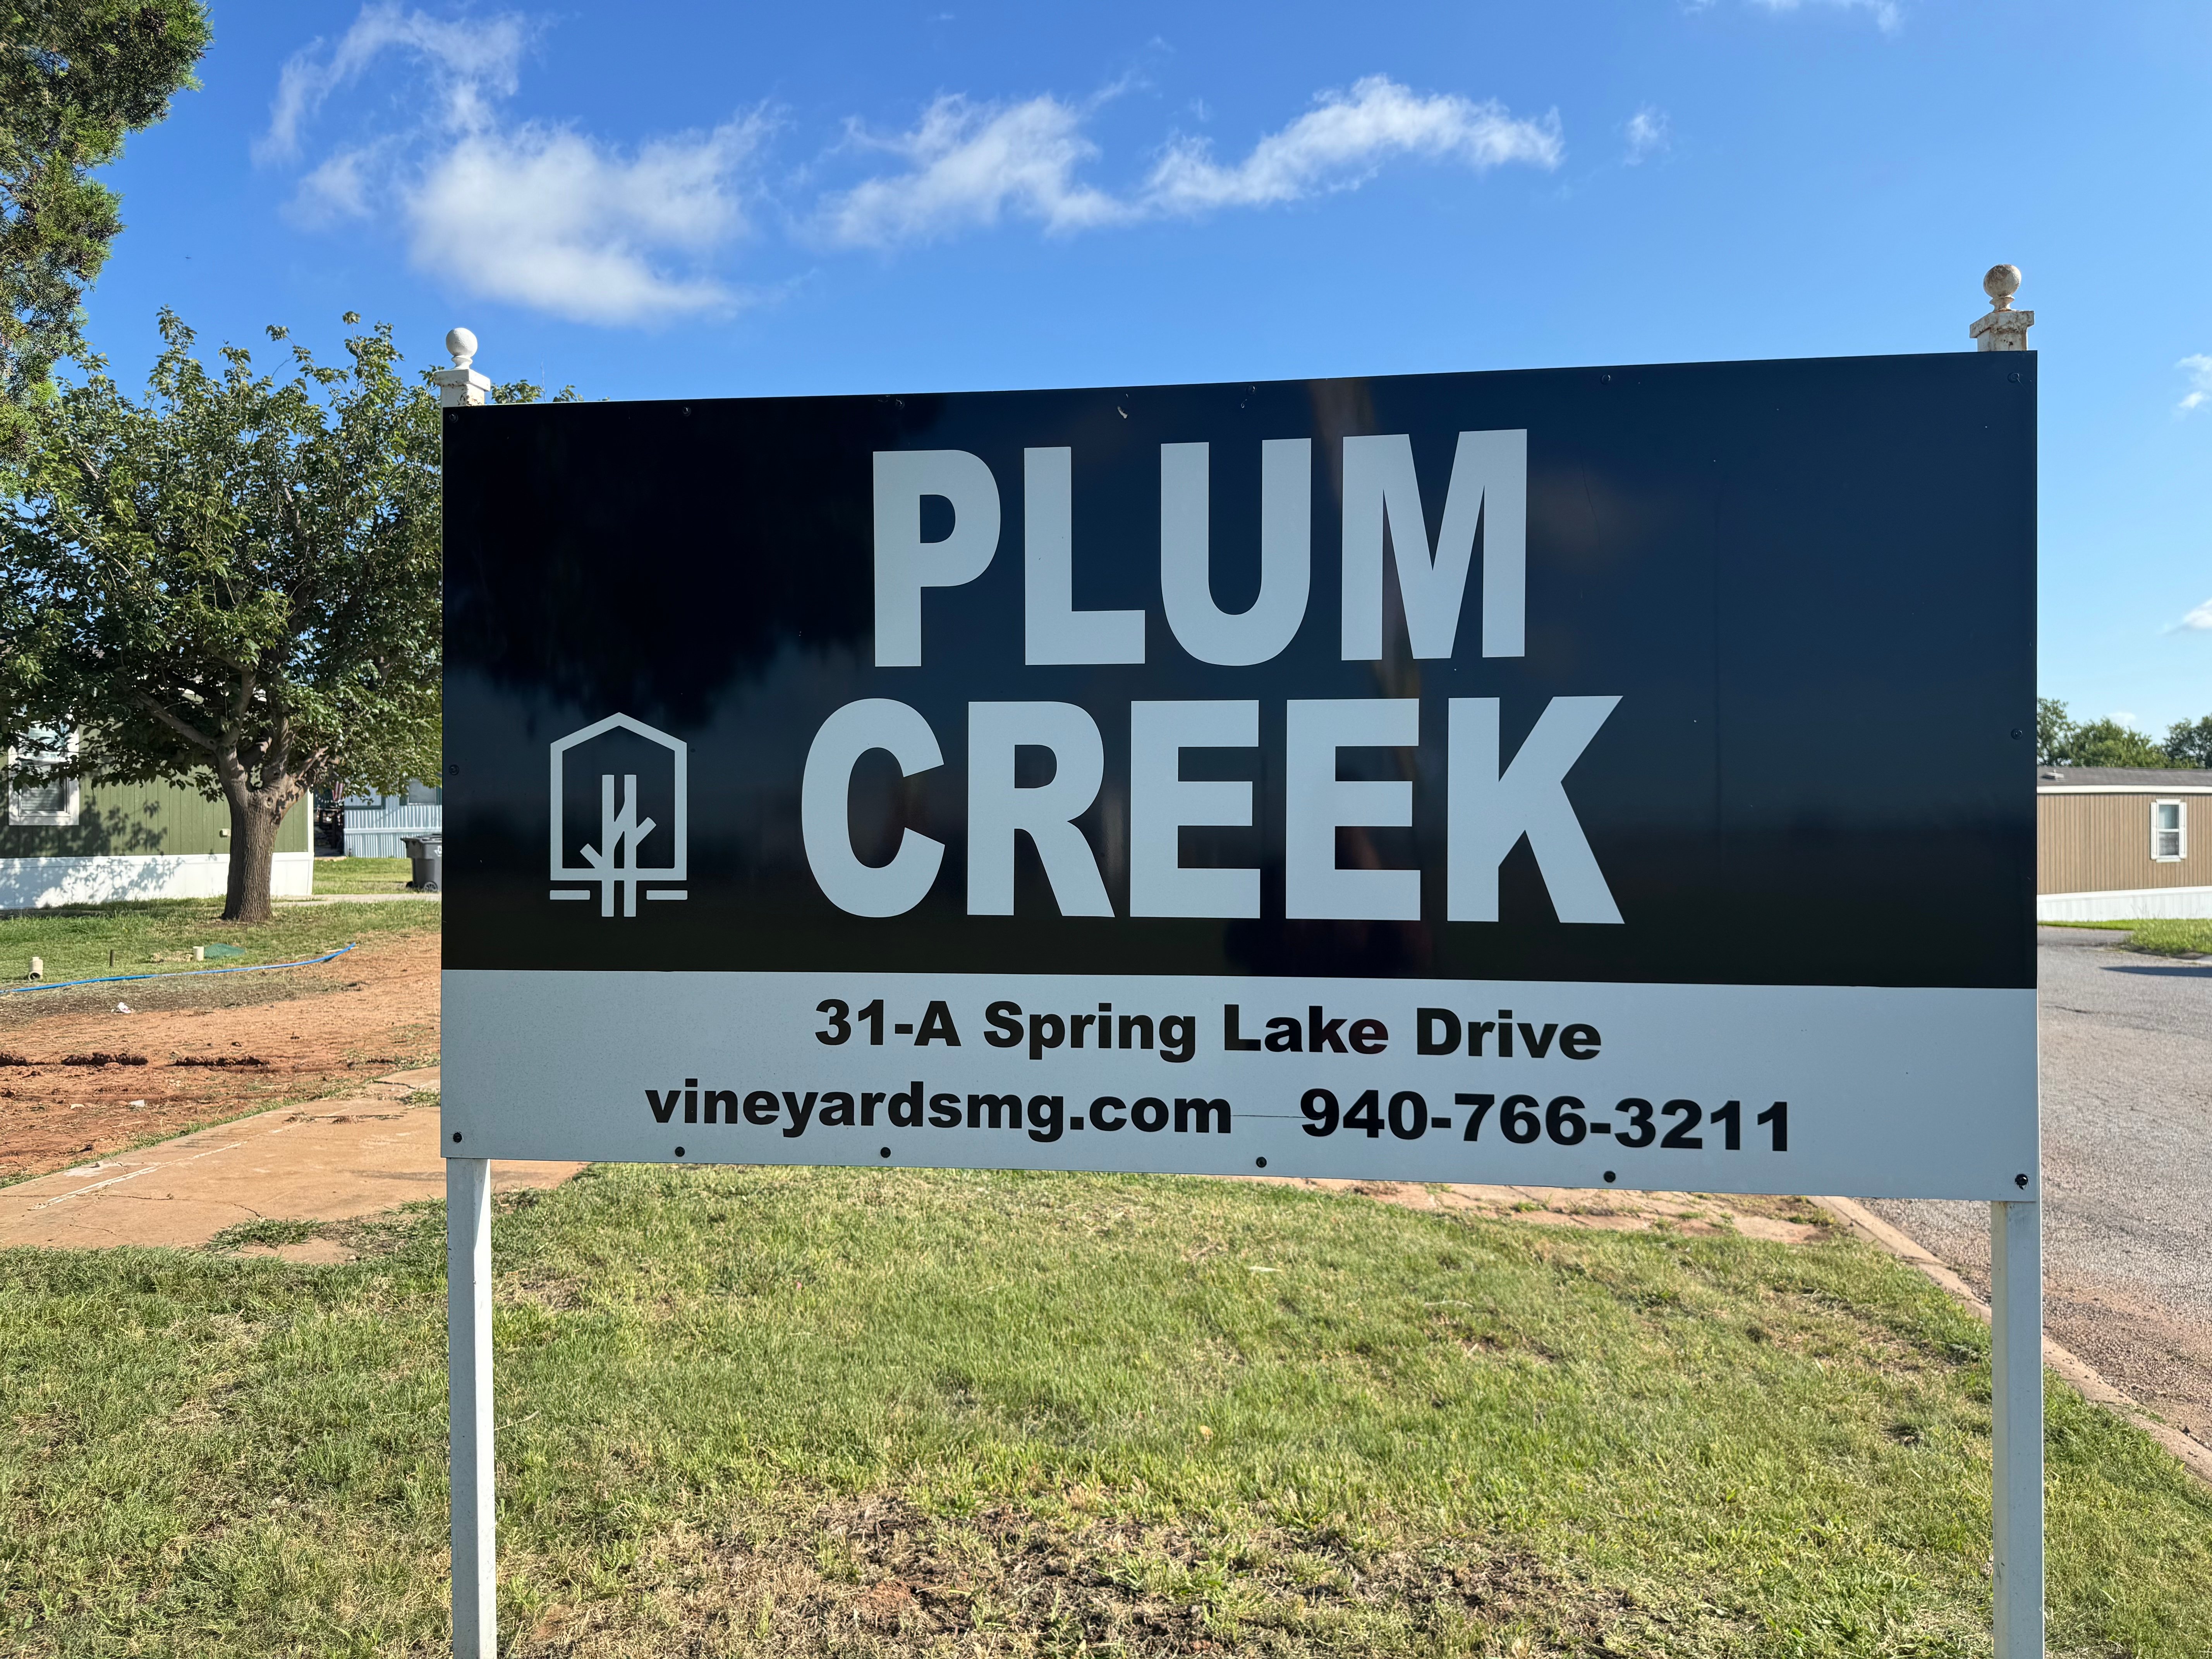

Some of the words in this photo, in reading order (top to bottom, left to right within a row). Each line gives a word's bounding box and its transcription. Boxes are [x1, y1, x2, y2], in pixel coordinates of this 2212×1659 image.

[872, 429, 1528, 667] PLUM
[801, 696, 1625, 926] CREEK
[815, 999, 962, 1046] 31-A
[984, 1001, 1195, 1063] Spring
[1224, 1004, 1389, 1054] Lake
[1417, 1008, 1602, 1060] Drive
[644, 1078, 1231, 1143] vineyardsmg.com
[1300, 1088, 1787, 1151] 940-766-3211
